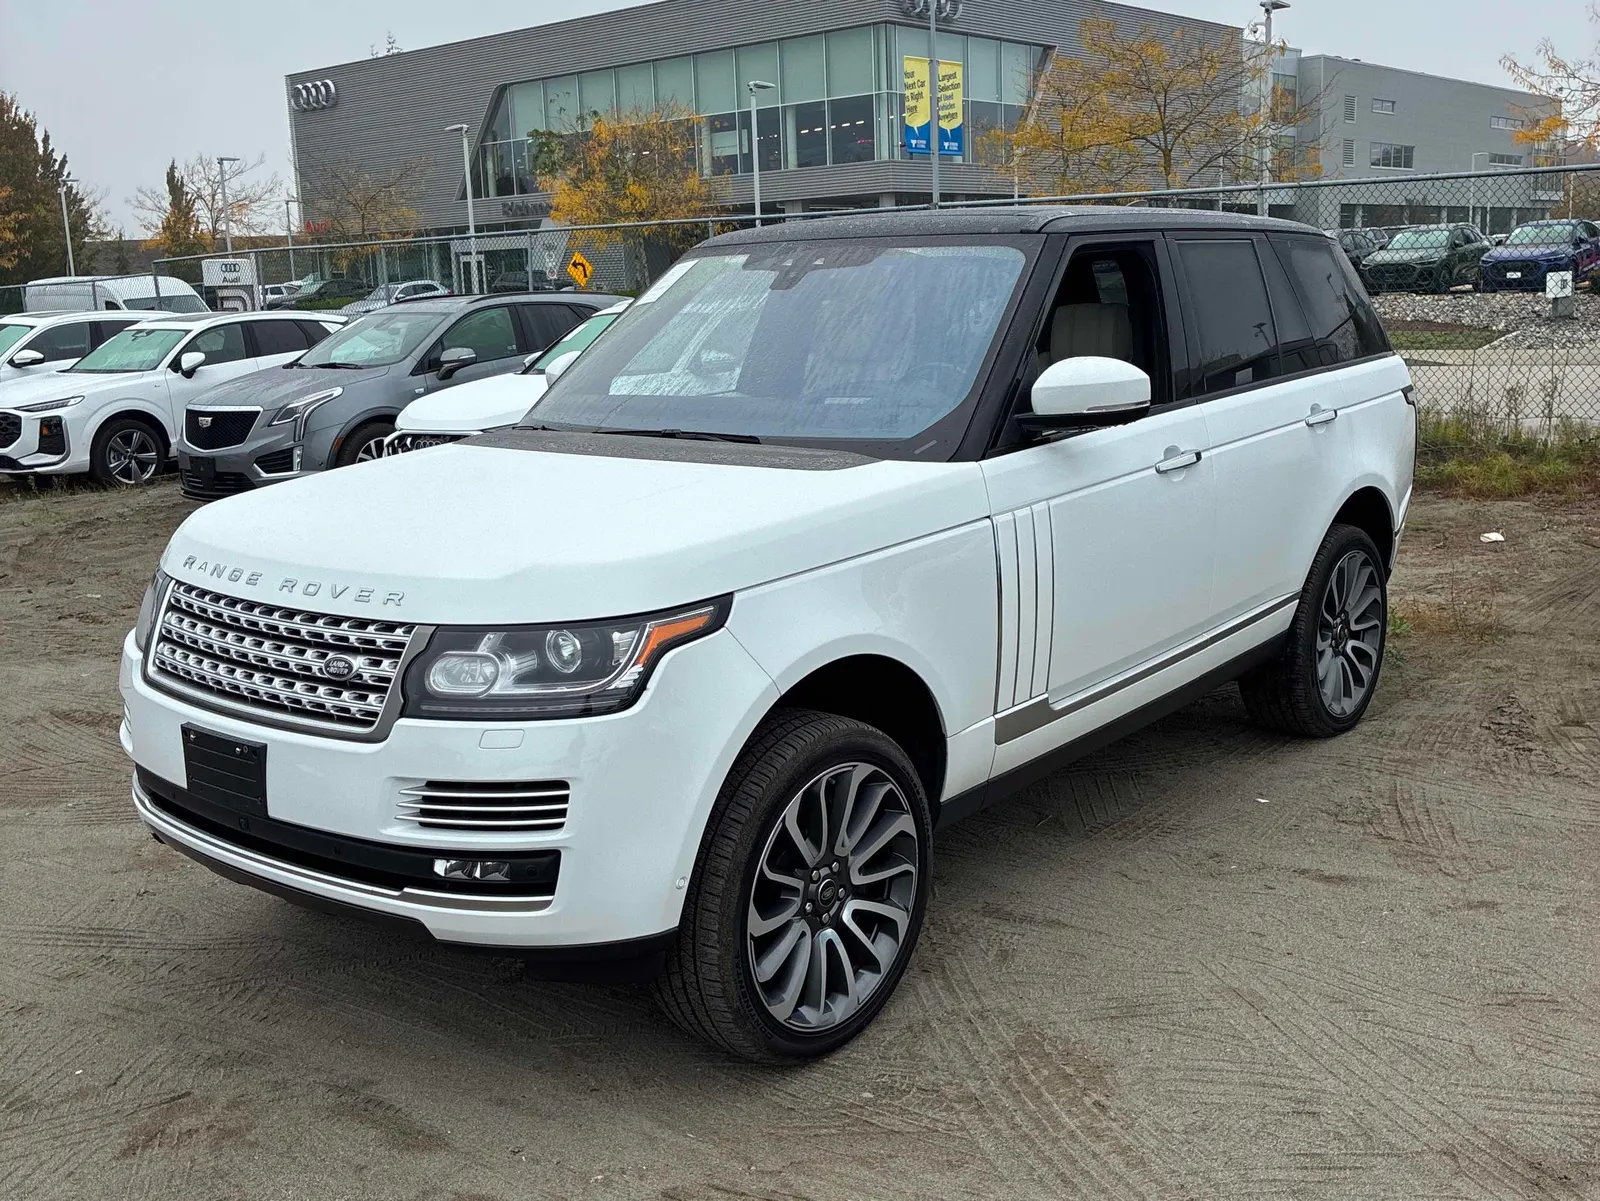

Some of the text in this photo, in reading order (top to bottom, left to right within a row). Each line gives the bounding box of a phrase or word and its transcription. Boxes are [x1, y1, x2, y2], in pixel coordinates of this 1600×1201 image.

[938, 71, 957, 83] Largest
[904, 79, 926, 91] Next Car
[938, 82, 961, 93] Selection
[910, 91, 924, 103] Right
[906, 104, 918, 114] Here
[222, 276, 241, 284] Audi
[182, 554, 405, 607] RANGE ROVER
[328, 660, 346, 668] LAND
[328, 666, 349, 675] ROVER
